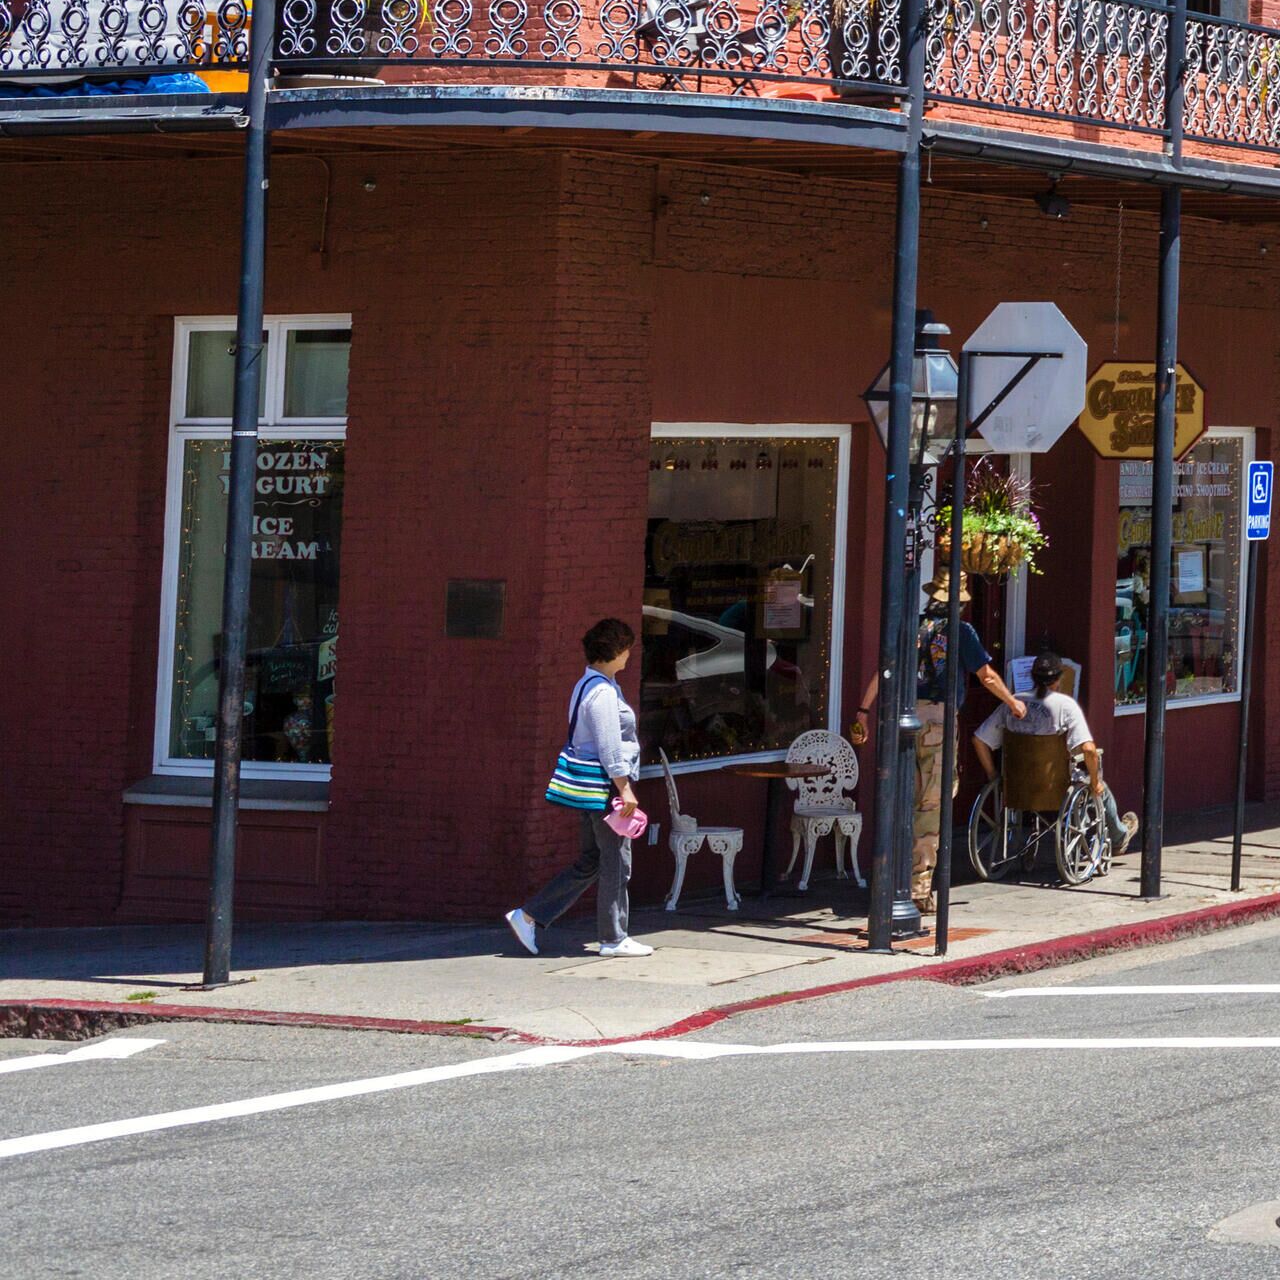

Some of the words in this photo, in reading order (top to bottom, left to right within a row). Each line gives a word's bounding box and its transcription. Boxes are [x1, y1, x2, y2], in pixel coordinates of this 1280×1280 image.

[222, 452, 329, 470] FOZEN
[218, 476, 329, 494] YGURT
[1248, 515, 1270, 529] PARKING
[223, 541, 318, 560] REAM
